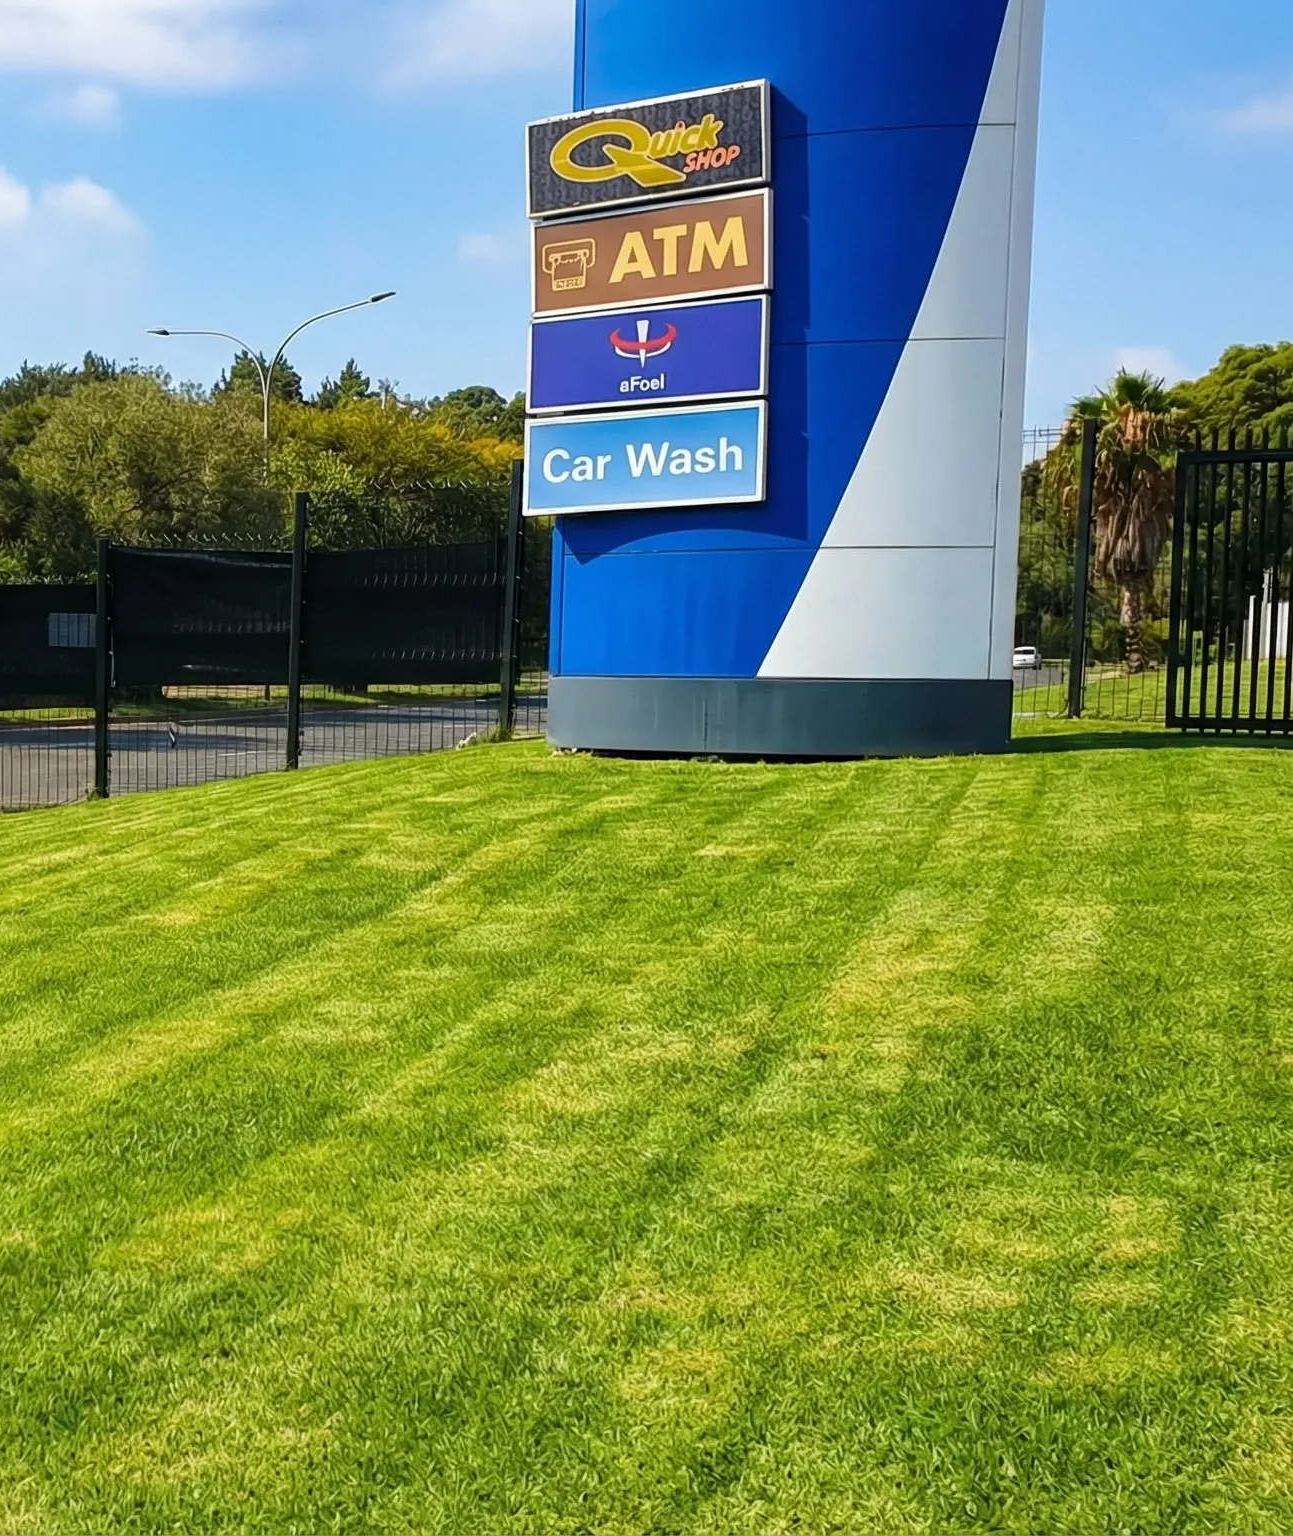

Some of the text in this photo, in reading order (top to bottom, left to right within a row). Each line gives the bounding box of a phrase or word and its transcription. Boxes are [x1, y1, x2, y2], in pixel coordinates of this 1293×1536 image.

[549, 113, 724, 188] Quick
[683, 145, 741, 173] SHOP
[608, 216, 749, 284] ATM
[619, 373, 665, 393] aFoel
[542, 436, 743, 484] Car Wash
